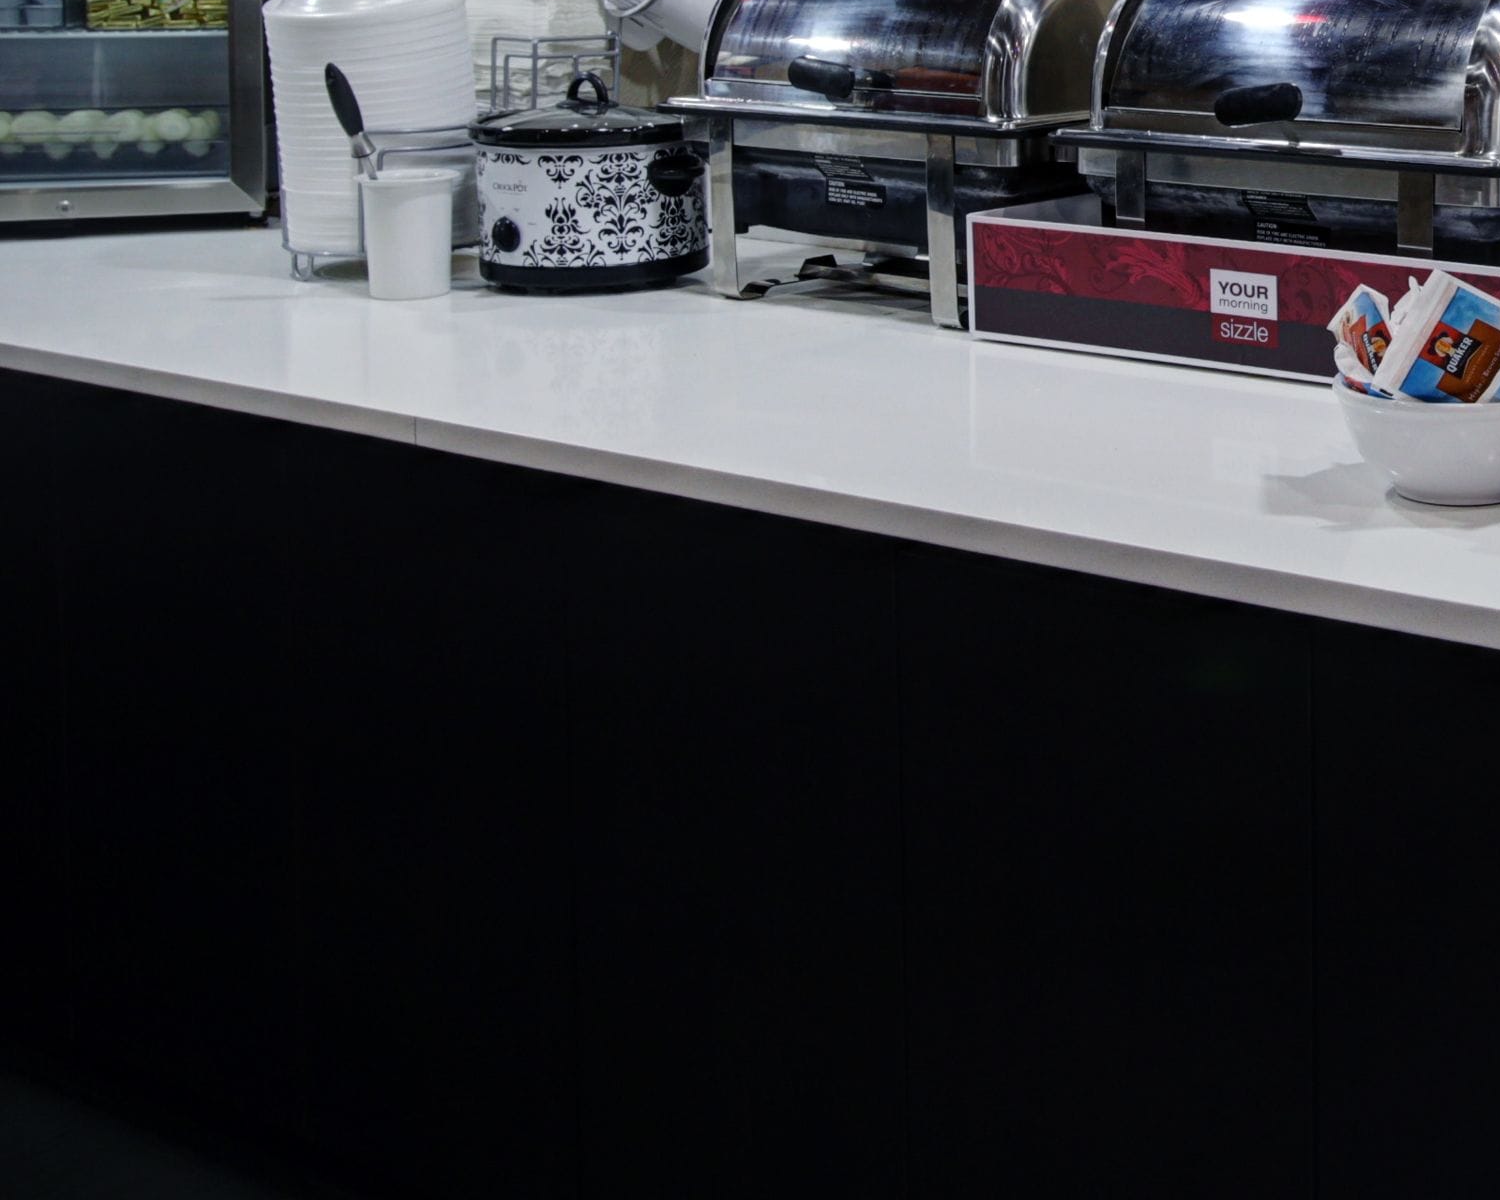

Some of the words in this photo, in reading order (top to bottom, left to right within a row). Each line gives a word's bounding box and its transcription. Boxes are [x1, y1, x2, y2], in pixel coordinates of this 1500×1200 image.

[1218, 281, 1268, 300] YOUR
[1219, 298, 1268, 315] morning
[1220, 318, 1269, 343] sizzle
[1446, 337, 1474, 373] QUAKER
[1482, 356, 1498, 377] Brown
